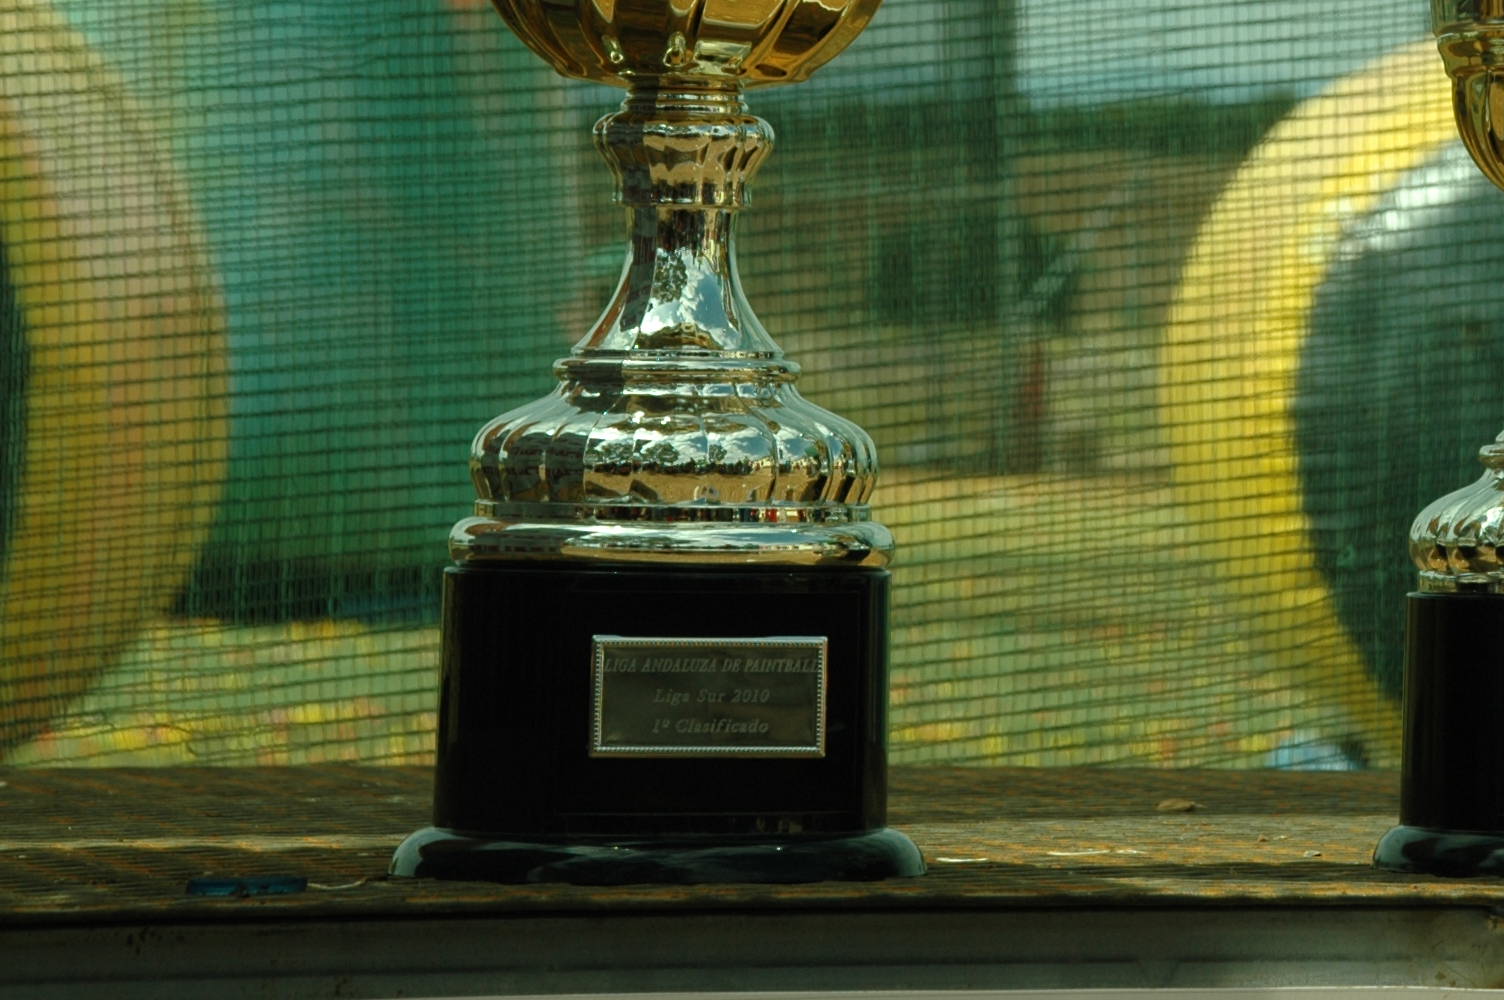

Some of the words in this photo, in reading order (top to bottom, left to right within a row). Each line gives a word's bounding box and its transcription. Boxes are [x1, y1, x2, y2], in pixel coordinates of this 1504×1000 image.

[604, 658, 637, 673] LIGA
[641, 658, 717, 673] ANDALUZA
[720, 658, 741, 673] DE
[652, 688, 690, 706] Liga
[696, 688, 726, 704] Sur
[730, 688, 771, 704] 2010
[675, 718, 769, 734] Clasificado
